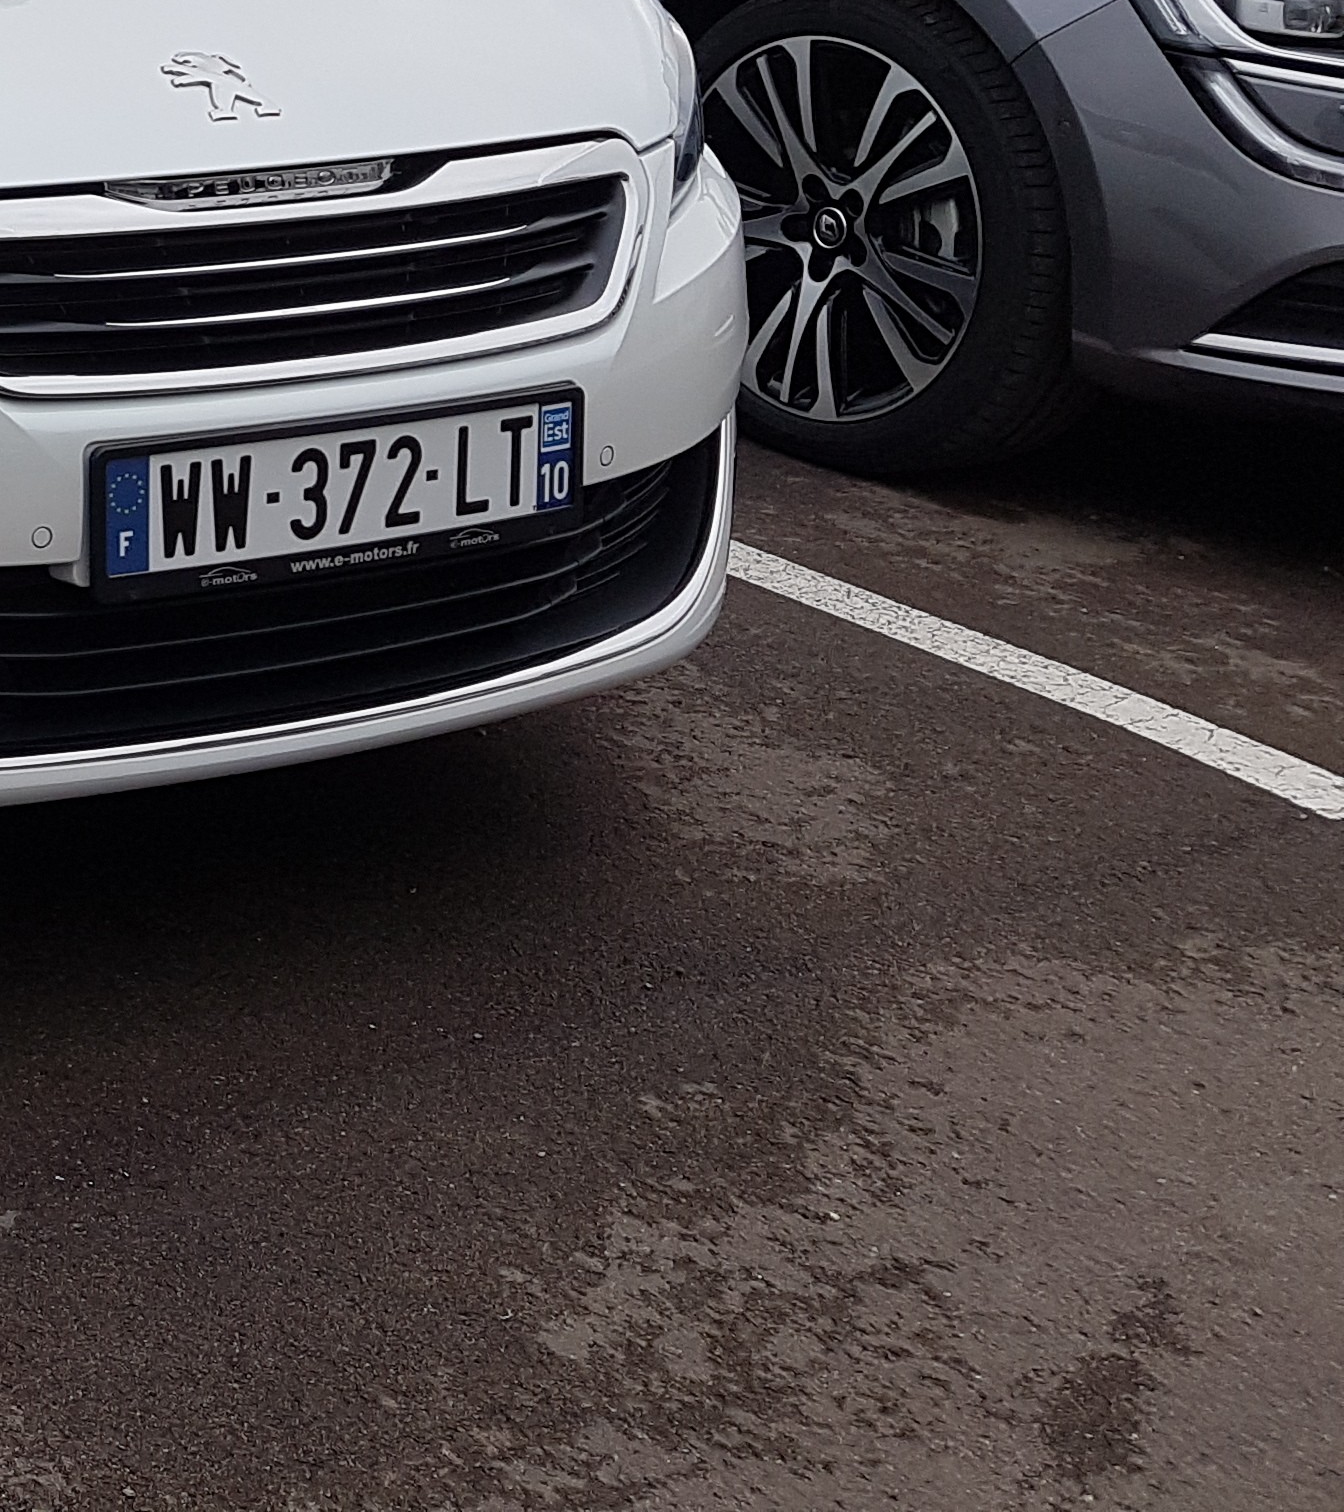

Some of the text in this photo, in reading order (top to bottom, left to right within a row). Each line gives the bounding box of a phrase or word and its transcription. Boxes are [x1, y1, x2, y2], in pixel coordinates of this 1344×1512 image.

[544, 410, 570, 423] Grand
[543, 422, 569, 442] Est
[160, 415, 534, 559] WW-372-LT
[540, 460, 570, 503] 10
[119, 530, 134, 557] F
[290, 540, 420, 574] www.e-motors.fr
